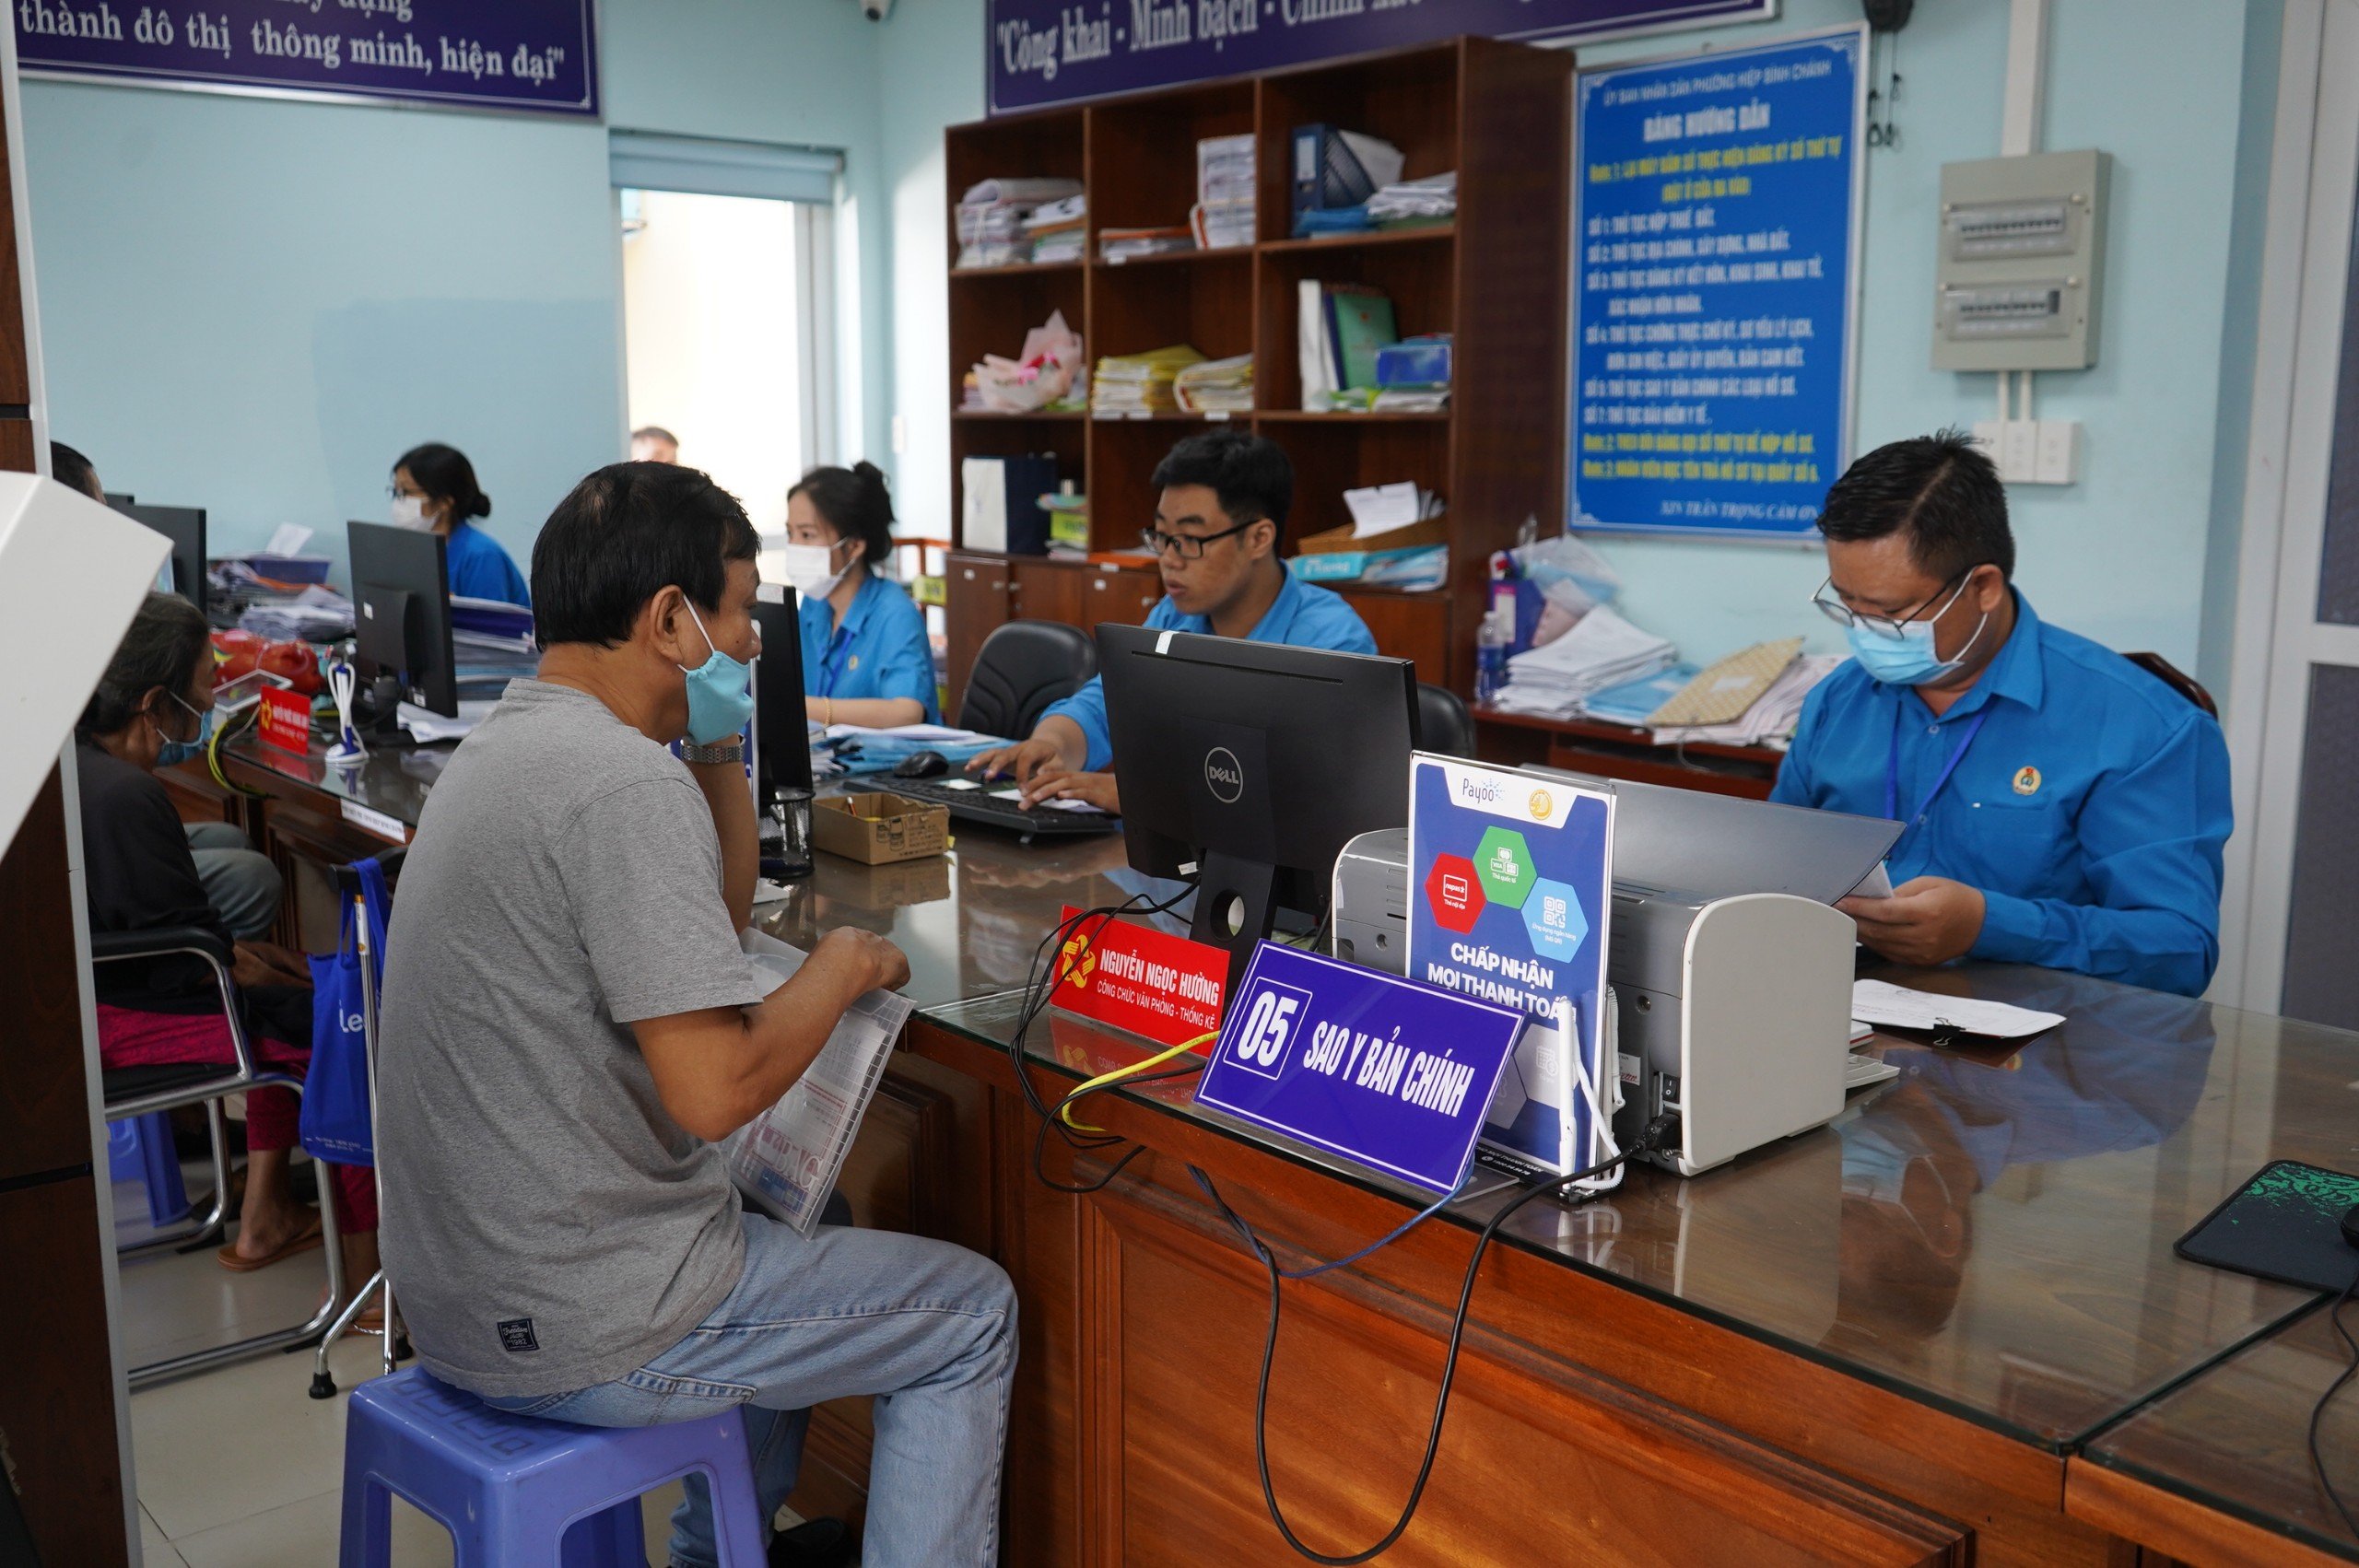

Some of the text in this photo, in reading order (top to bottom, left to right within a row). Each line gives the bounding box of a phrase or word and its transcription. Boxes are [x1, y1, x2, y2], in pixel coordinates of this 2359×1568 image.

[18, 0, 565, 87] thành đô thị thông minh, hiện đại"
[1062, 2, 1111, 64] khai
[1130, 0, 1191, 53] Minh
[1209, 766, 1238, 784] DELL
[1462, 778, 1494, 803] Payoo
[1099, 949, 1219, 1006] NGUYỄN NGỌC HƯỜNG
[1427, 963, 1461, 990] MỌI
[1461, 973, 1523, 1012] THANH
[1450, 942, 1554, 989] CHẤP NHẬN
[1097, 979, 1116, 998] CÔNG
[1117, 986, 1135, 1004] CHỨC
[1136, 991, 1150, 1009] VĂN
[1151, 996, 1174, 1016] PHÒNG
[1180, 1005, 1203, 1026] THỐNG
[1204, 1013, 1215, 1030] KÊ
[1238, 990, 1298, 1067] 05
[1303, 1021, 1475, 1117] SAO Y BẢN CHÍNH
